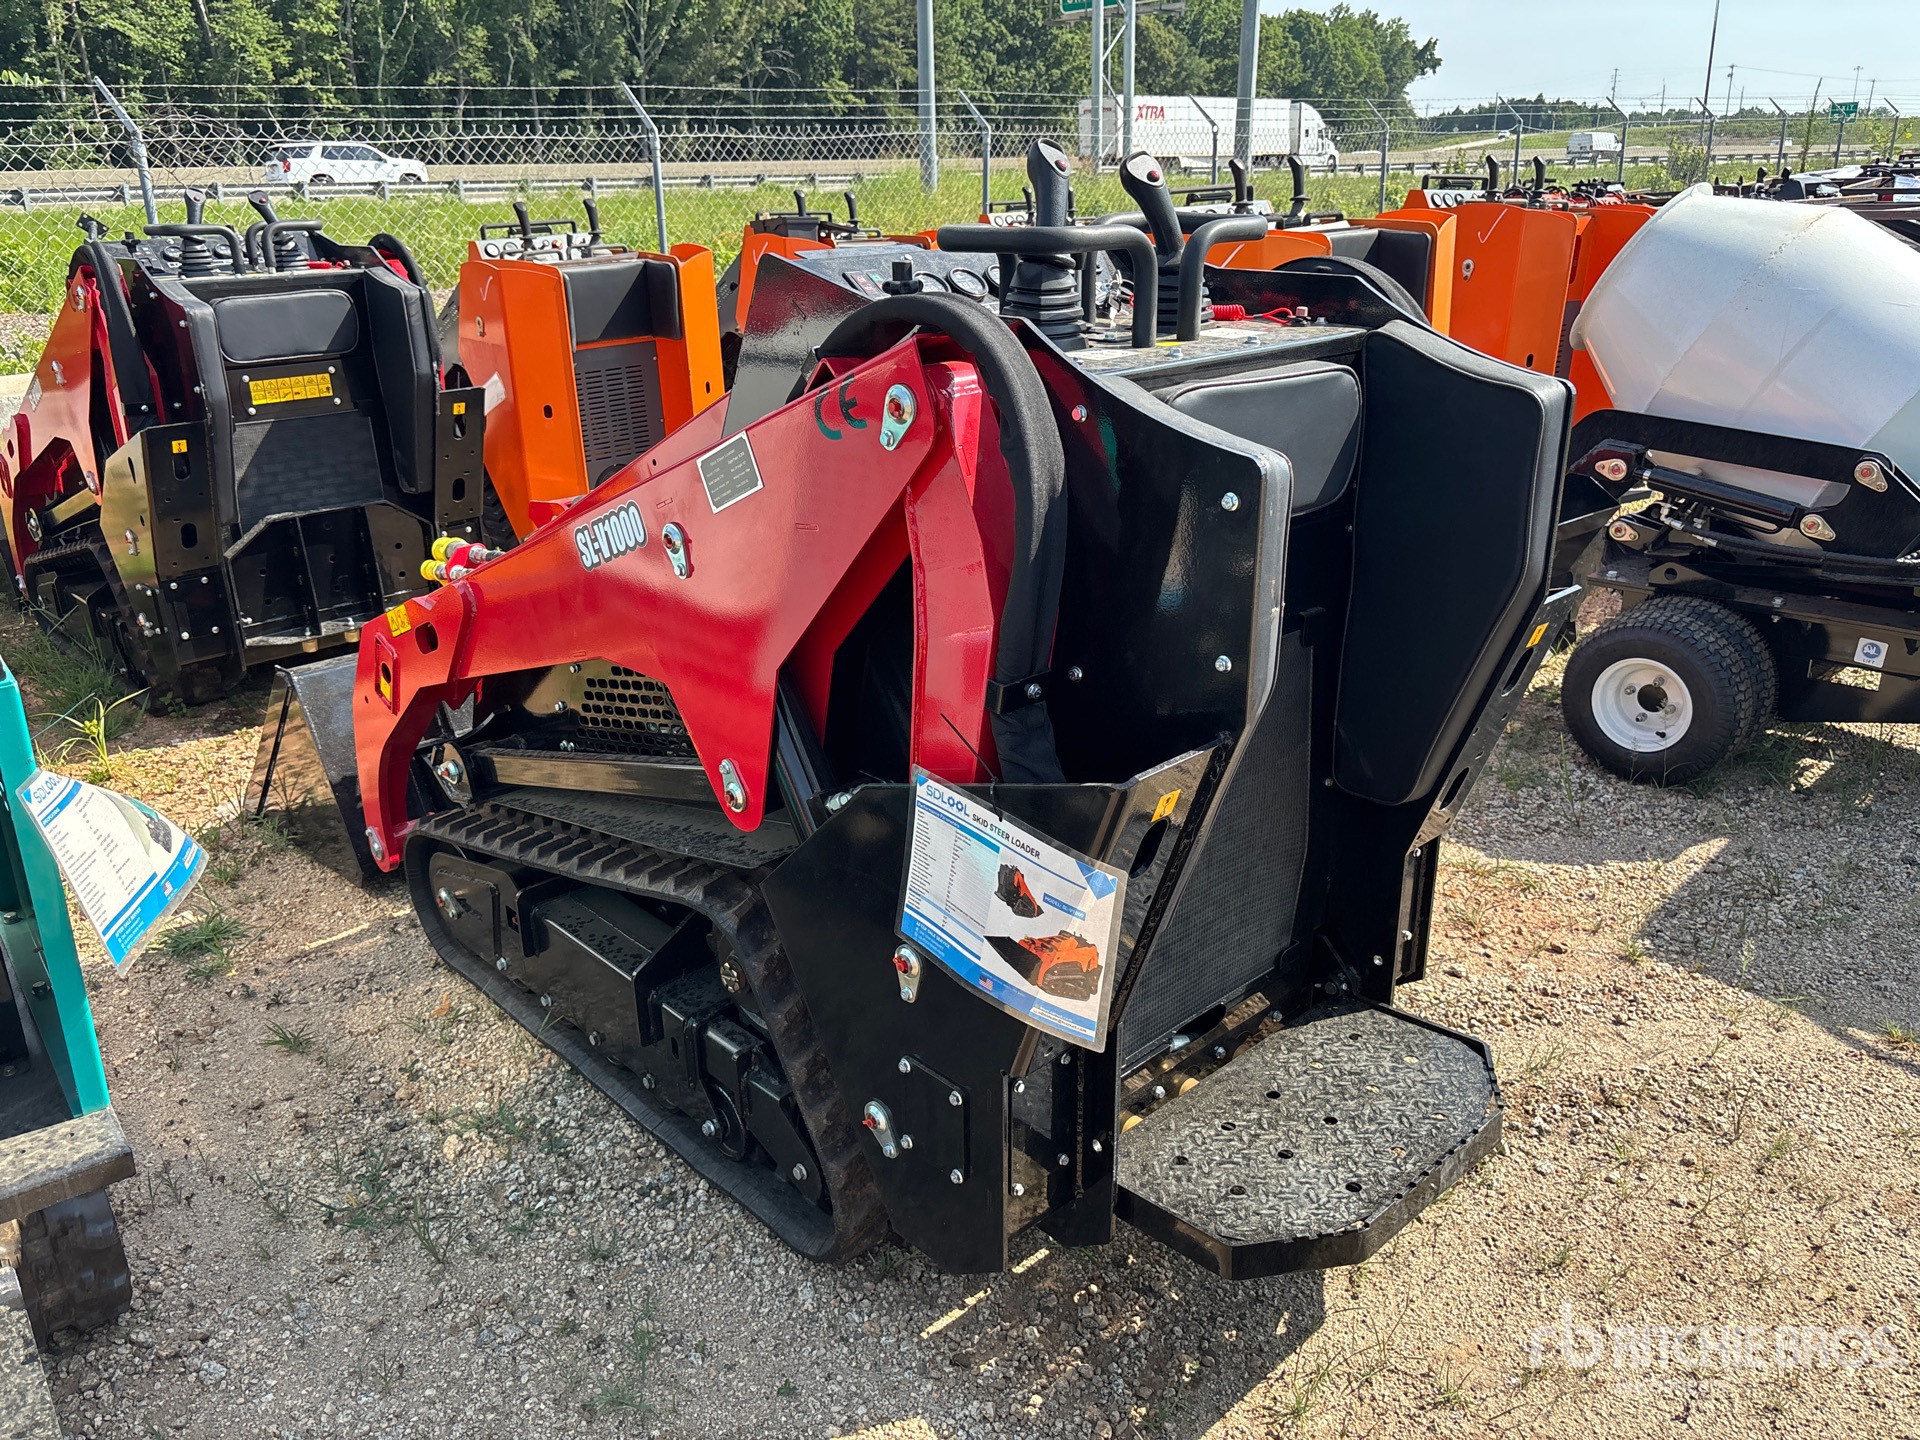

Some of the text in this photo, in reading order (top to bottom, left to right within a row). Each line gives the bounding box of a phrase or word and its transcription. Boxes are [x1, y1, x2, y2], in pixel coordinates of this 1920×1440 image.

[1134, 103, 1165, 122] XTRA
[814, 373, 868, 441] CE
[575, 502, 647, 570] SL-V1000
[925, 784, 1041, 860] SDLOOL SKID STEER LOADER
